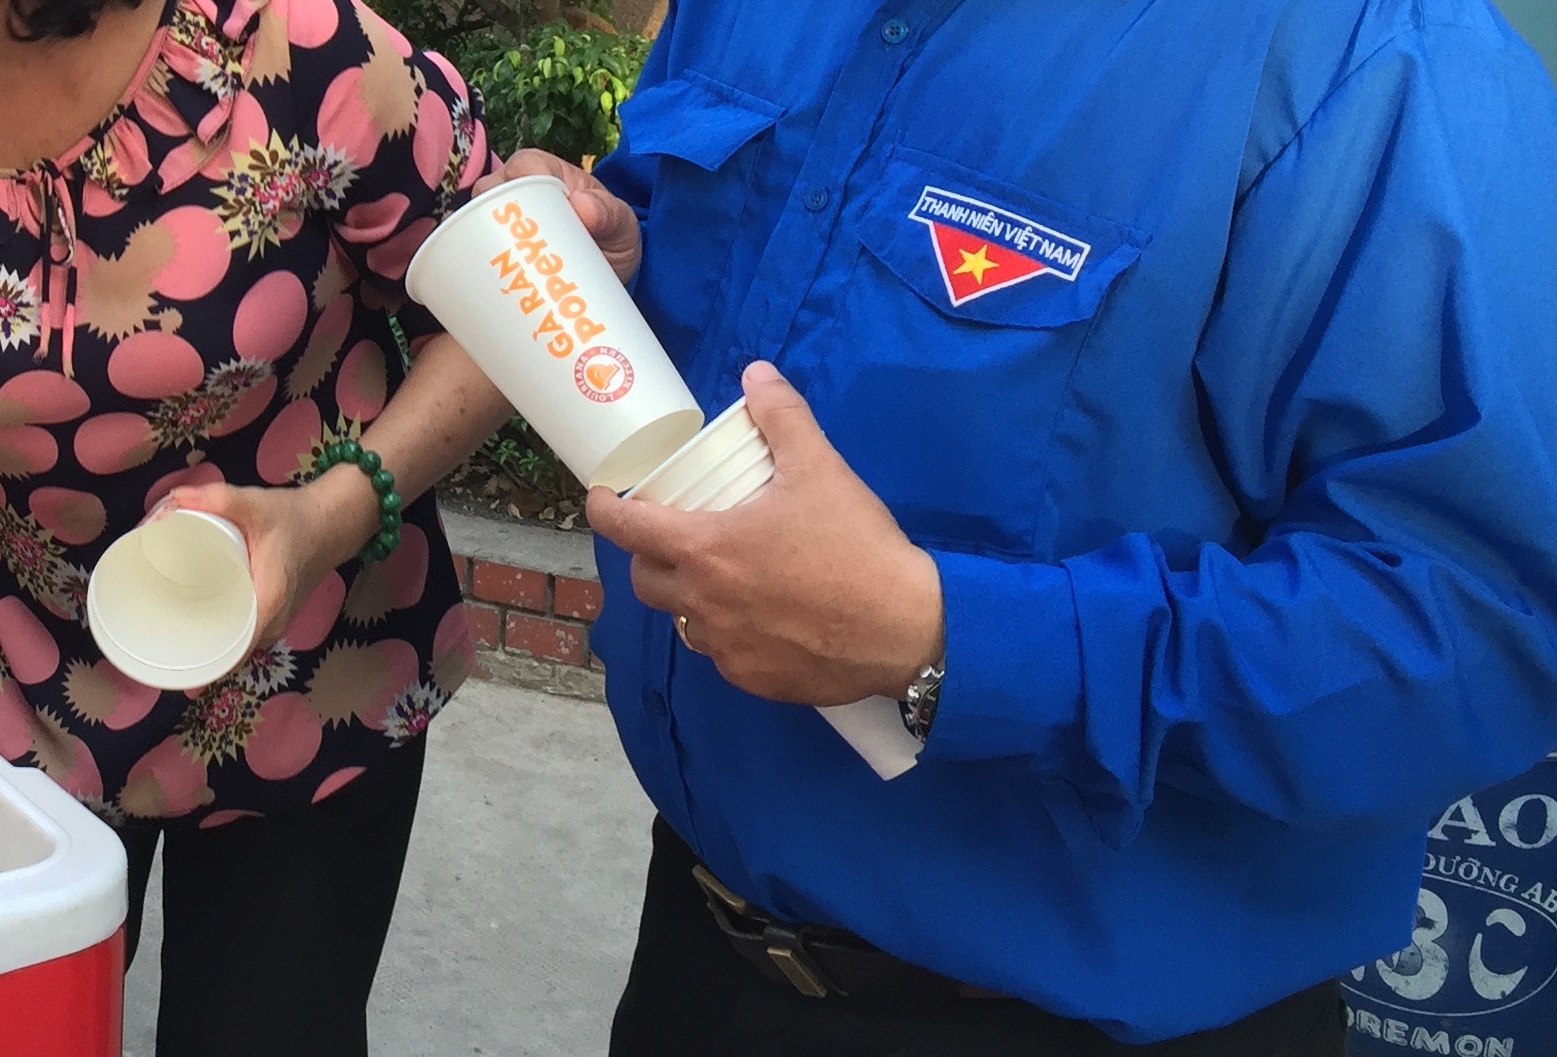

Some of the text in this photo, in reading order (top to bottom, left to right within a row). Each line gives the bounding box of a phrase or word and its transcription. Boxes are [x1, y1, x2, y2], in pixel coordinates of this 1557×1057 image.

[921, 196, 1081, 269] THANH NIÊN VIỆT NAM
[490, 248, 574, 359] GÀ RÁN
[1345, 1005, 1514, 1057] REMON
